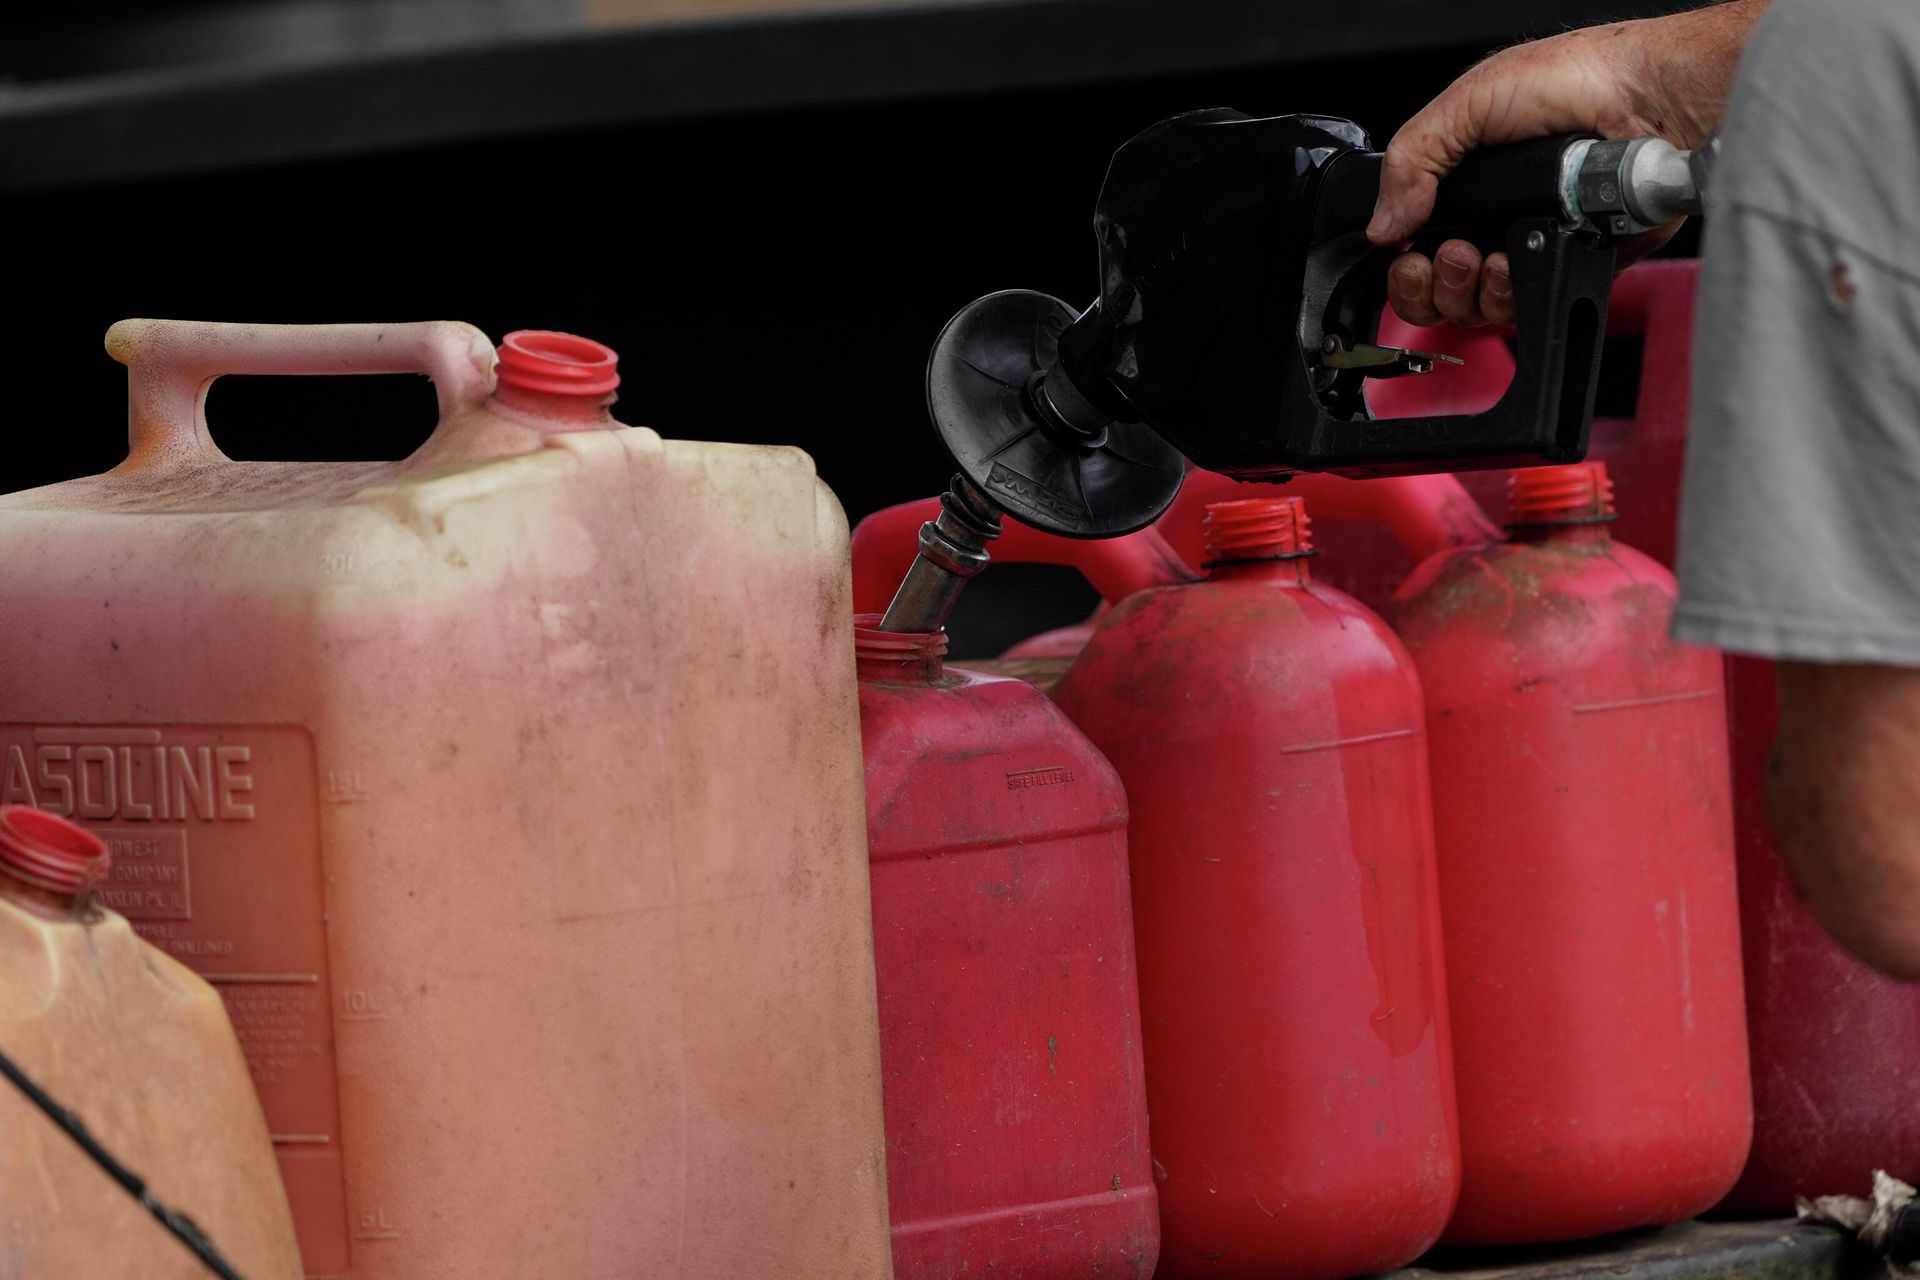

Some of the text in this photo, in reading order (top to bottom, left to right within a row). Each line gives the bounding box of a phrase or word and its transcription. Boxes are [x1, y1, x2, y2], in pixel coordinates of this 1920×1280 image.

[1007, 770, 1075, 790] SAFE FILL LEVEL
[116, 865, 179, 882] COMPANY
[97, 890, 142, 908] ANKLIN
